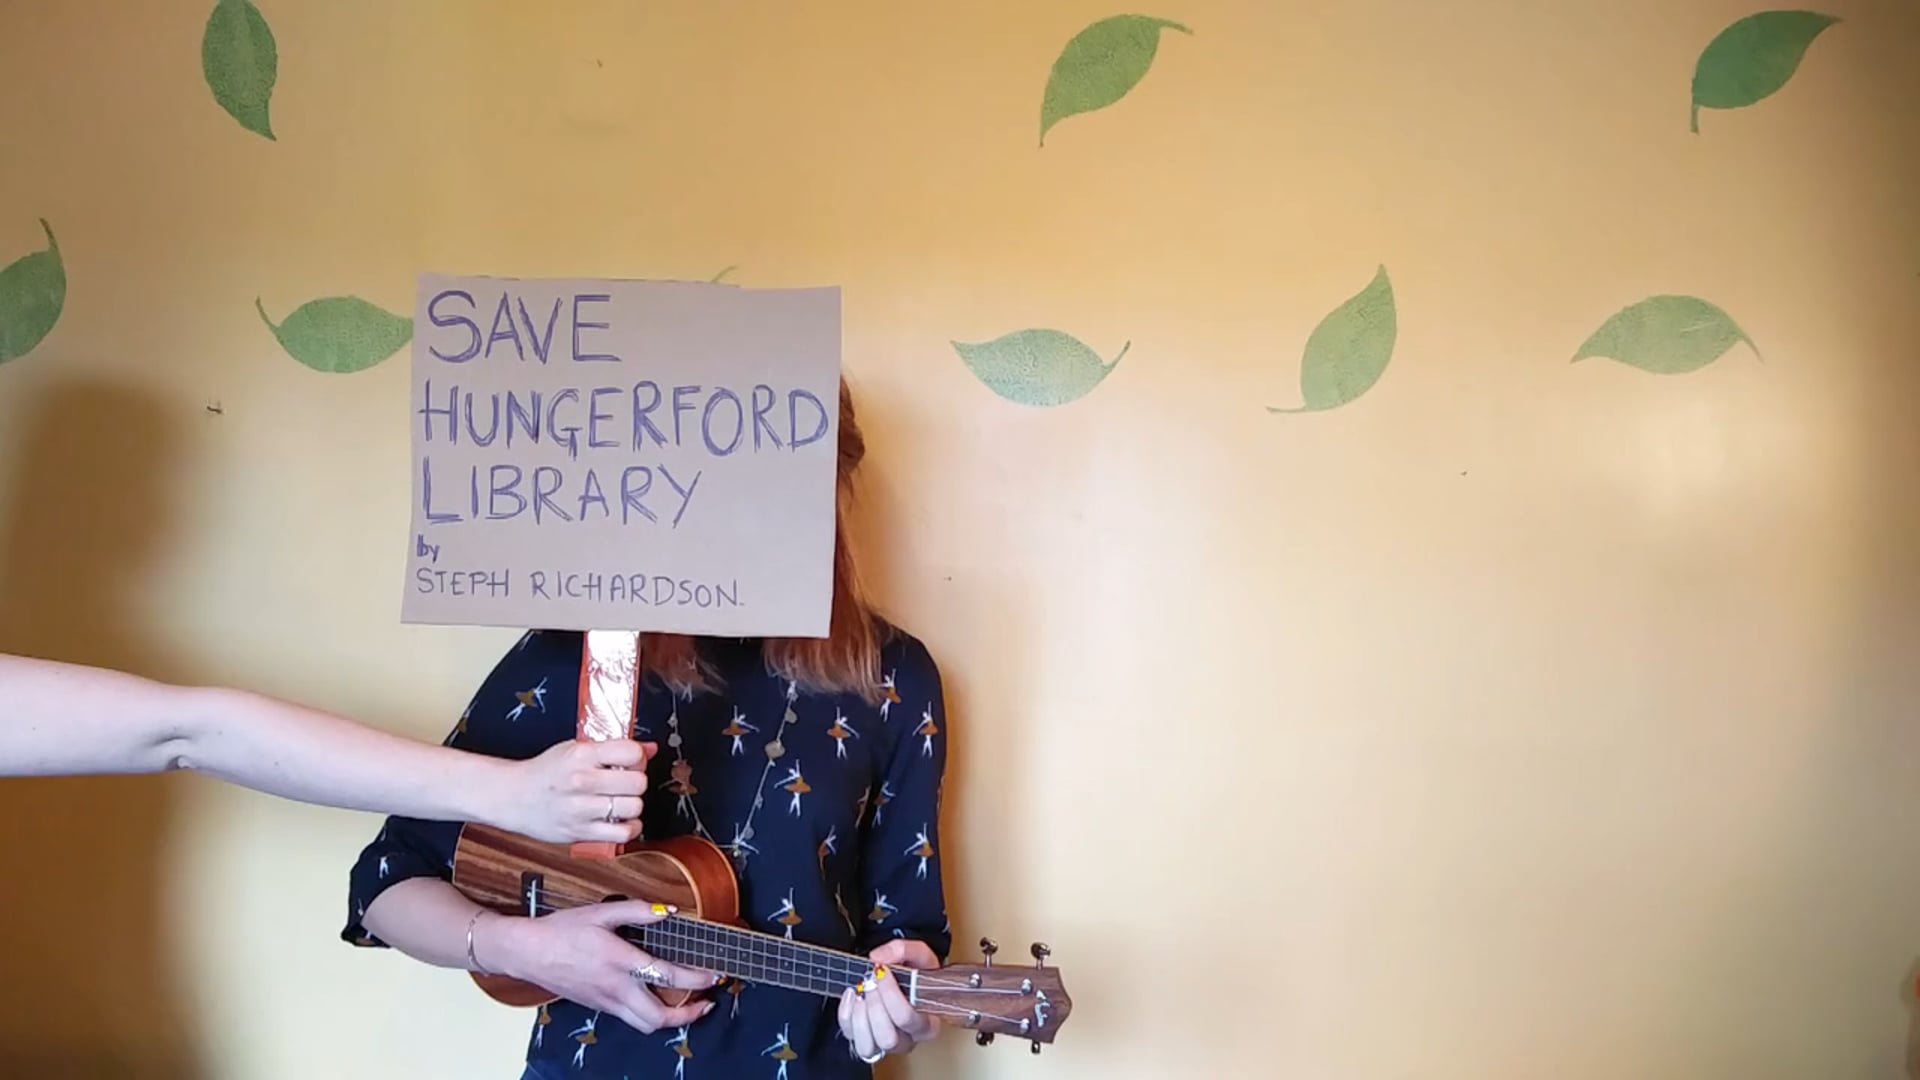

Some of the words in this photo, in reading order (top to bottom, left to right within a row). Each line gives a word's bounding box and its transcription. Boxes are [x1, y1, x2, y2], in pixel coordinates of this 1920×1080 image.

[427, 289, 623, 365] SAVE
[418, 379, 830, 461] HUNGERFORD
[421, 455, 703, 529] LIBRARY
[416, 534, 440, 564] by
[416, 567, 510, 598] STEPH
